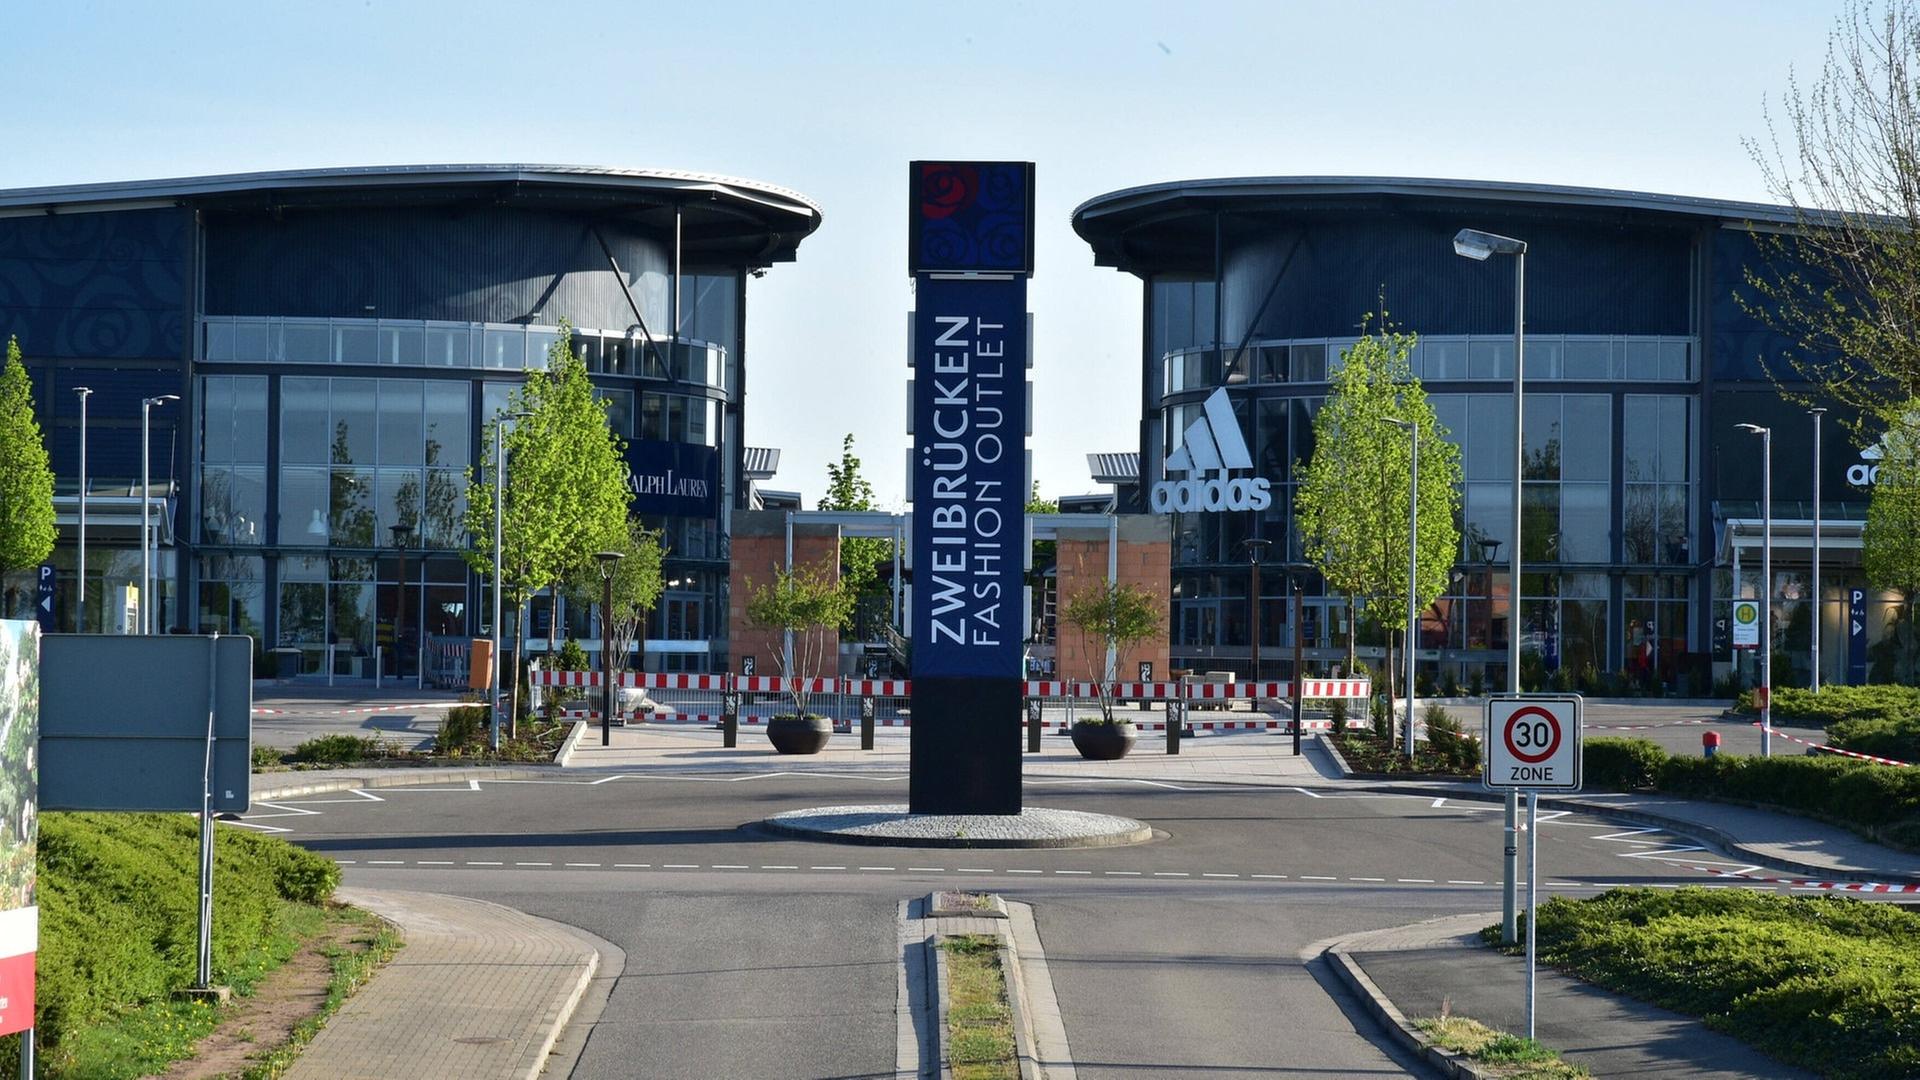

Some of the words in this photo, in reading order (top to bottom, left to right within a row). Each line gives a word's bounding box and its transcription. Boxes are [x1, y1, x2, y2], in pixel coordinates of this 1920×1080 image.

[975, 316, 1004, 464] OUTLET
[666, 469, 708, 498] LAUREN
[923, 316, 969, 645] ZWEIBRÜCKEN
[1151, 469, 1271, 514] adidas
[41, 566, 52, 580] P
[973, 481, 1002, 645] FASHION
[1853, 590, 1863, 604] P
[1515, 721, 1549, 748] 30
[1510, 766, 1554, 781] ZONE
